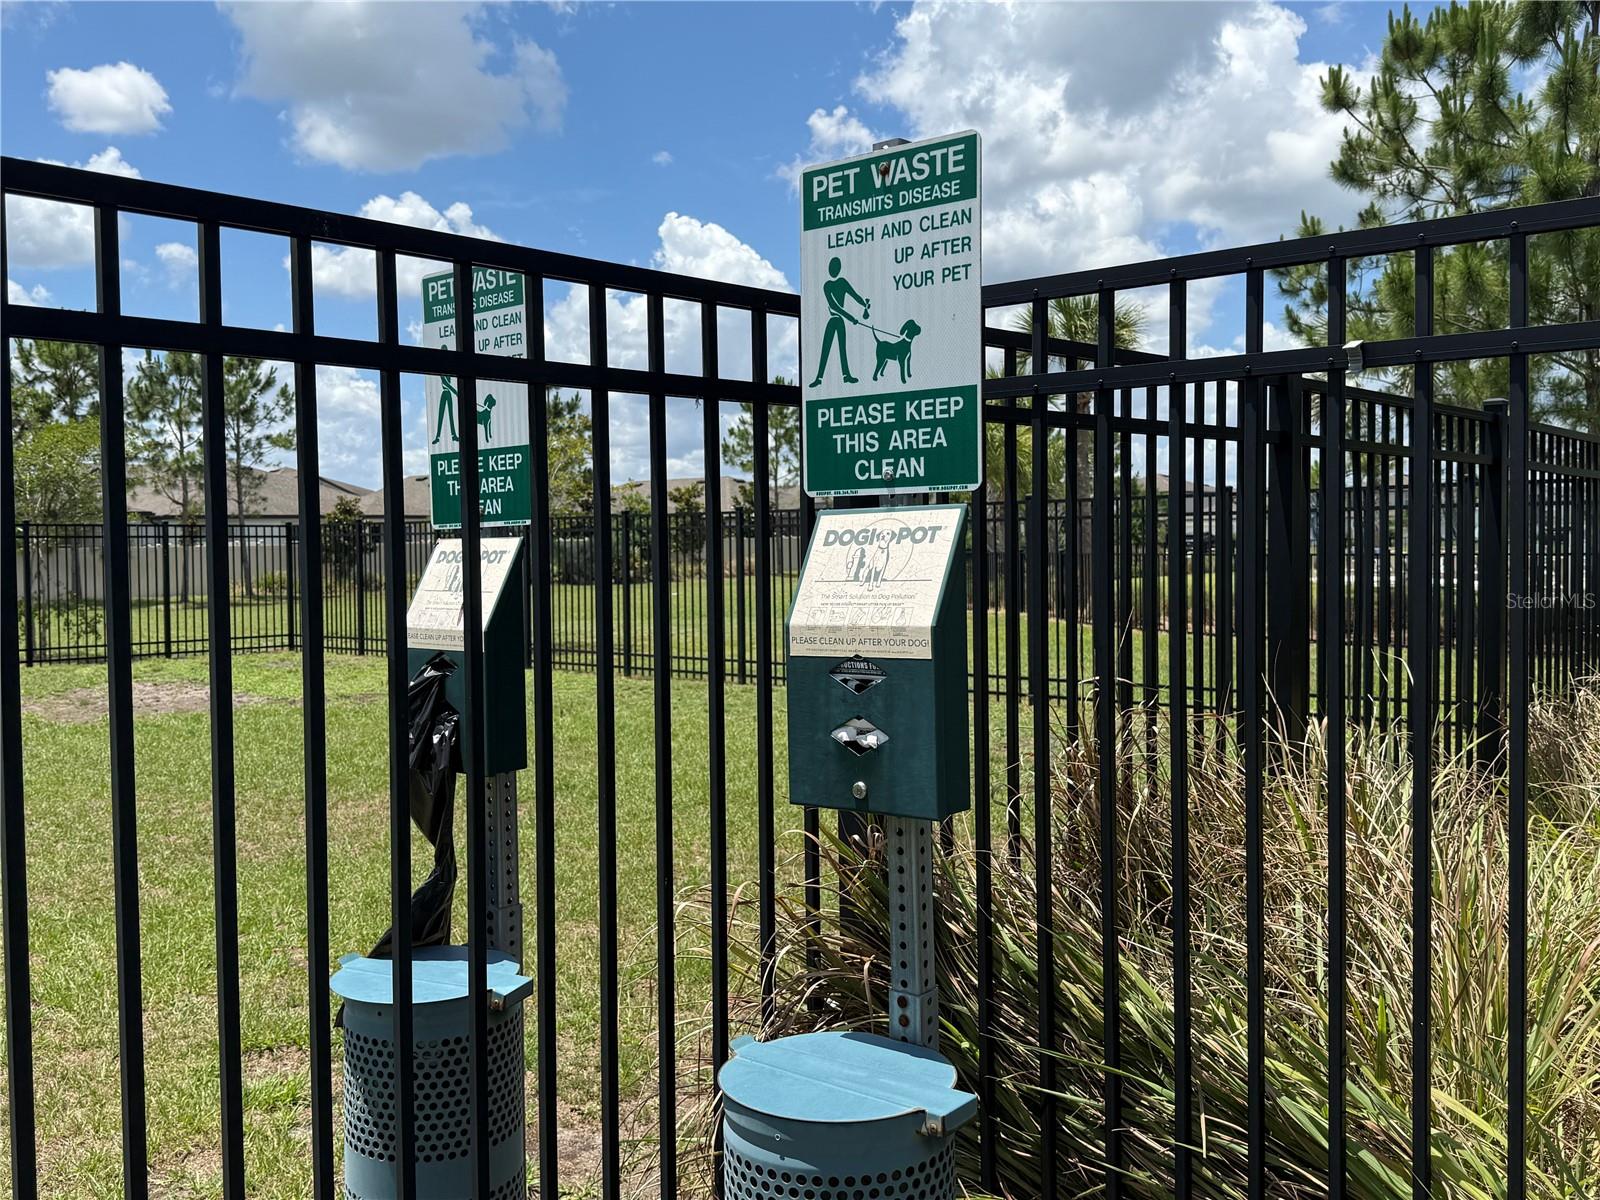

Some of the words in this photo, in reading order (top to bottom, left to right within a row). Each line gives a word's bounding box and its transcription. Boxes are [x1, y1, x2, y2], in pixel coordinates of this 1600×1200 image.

[812, 167, 860, 202] PET
[870, 144, 965, 189] WASTE
[817, 193, 893, 222] TRANSMITS
[899, 180, 961, 207] DISEASE
[827, 226, 875, 249] LEASH
[881, 219, 912, 240] AND
[919, 207, 972, 232] CLEAN
[894, 246, 914, 264] UP
[920, 236, 972, 260] AFTER
[428, 277, 454, 302] PET
[893, 270, 935, 290] YOUR
[942, 263, 972, 284] PET
[480, 290, 514, 308] DISEASE
[439, 325, 455, 339] LEA
[474, 318, 488, 332] ND
[492, 311, 522, 329] CLEAN
[478, 338, 490, 352] UP
[493, 332, 523, 350] AFTER
[817, 402, 896, 428] PLEASE
[905, 396, 964, 421] KEEP
[832, 431, 880, 454] THIS
[888, 426, 948, 450] AREA
[488, 453, 522, 472] KEEP
[854, 456, 925, 481] CLEAN
[480, 475, 514, 494] AREA
[791, 636, 818, 645] PLEASE
[819, 637, 844, 646] CLEAN
[846, 637, 856, 646] UP
[858, 638, 883, 647] AFTER
[883, 638, 907, 647] YOUR
[908, 638, 930, 648] DOG!
